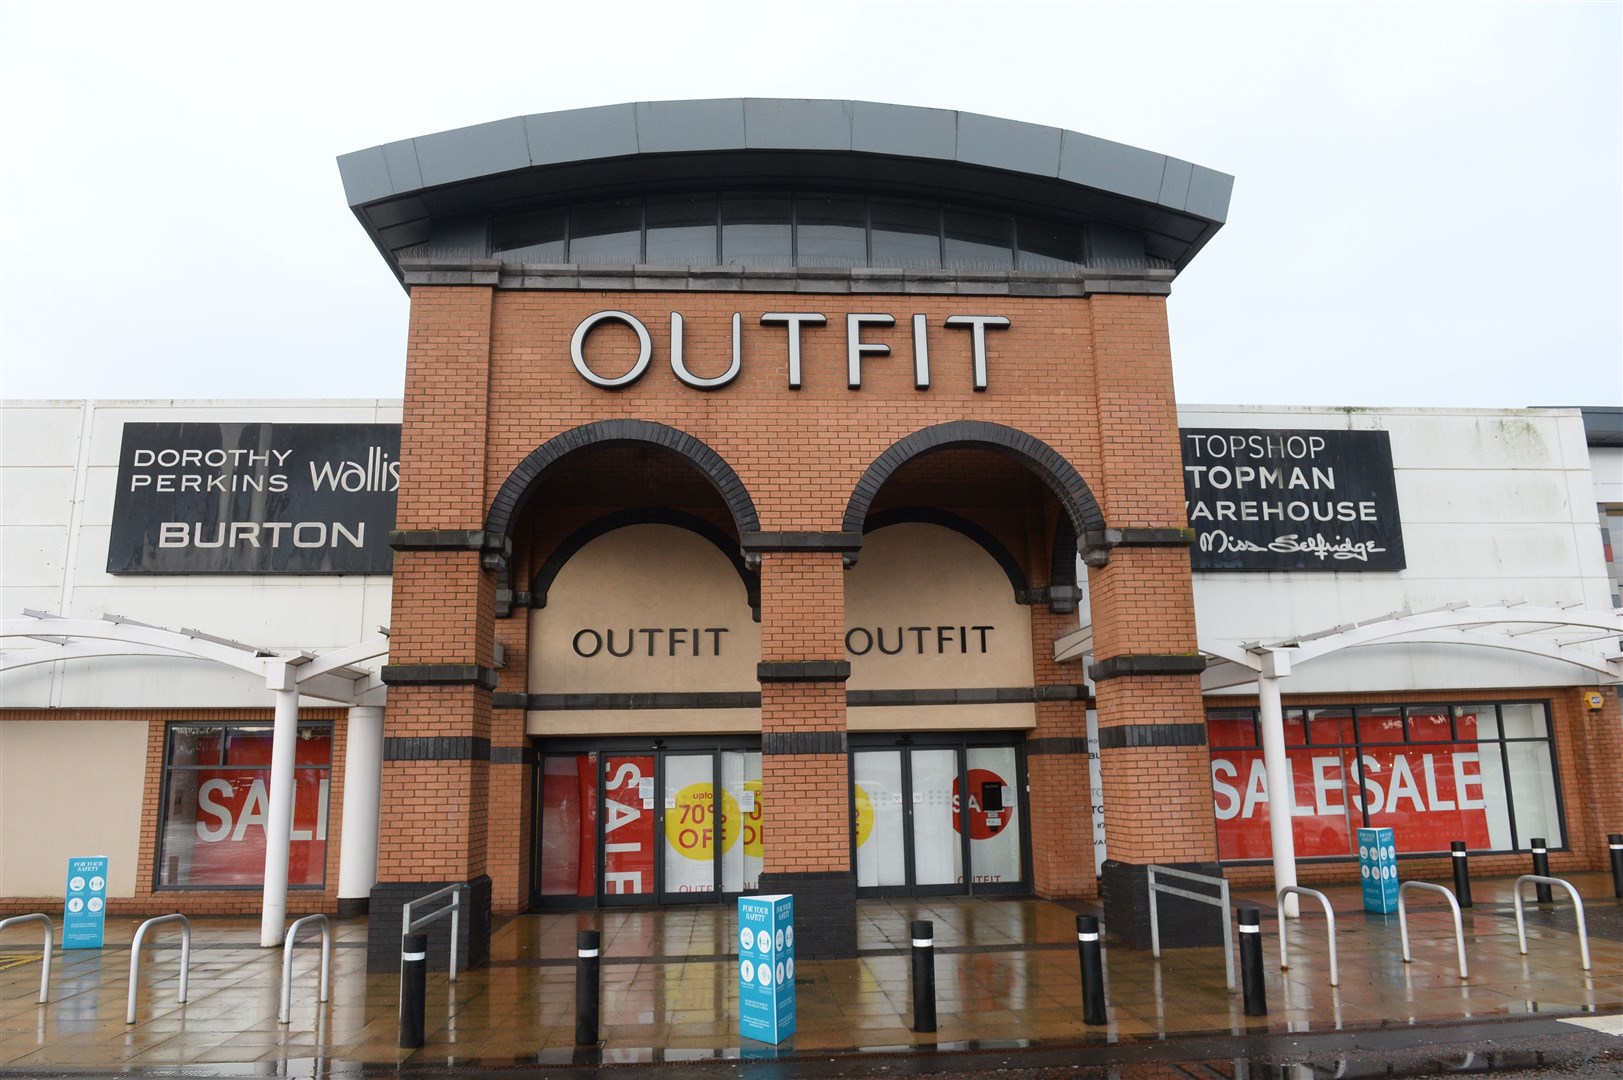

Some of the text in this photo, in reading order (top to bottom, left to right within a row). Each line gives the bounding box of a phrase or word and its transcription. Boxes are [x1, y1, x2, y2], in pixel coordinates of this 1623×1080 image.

[570, 309, 1011, 391] OUTFIT
[134, 449, 293, 467] DOROTHY
[1187, 434, 1325, 459] TOPSHOP
[131, 474, 289, 492] PERKINS
[1185, 465, 1335, 489] TOPMAN
[1185, 500, 1377, 521] AREHOUSE
[159, 522, 365, 548] BURTON
[1200, 529, 1386, 562] Miss Selfridge
[572, 628, 729, 658] OUTFIT
[845, 626, 995, 655] OUTFIT
[1211, 758, 1345, 820] SALE
[1350, 752, 1485, 815] SALE
[742, 904, 769, 915] FOR YOUR
[745, 913, 766, 922] SAFETY
